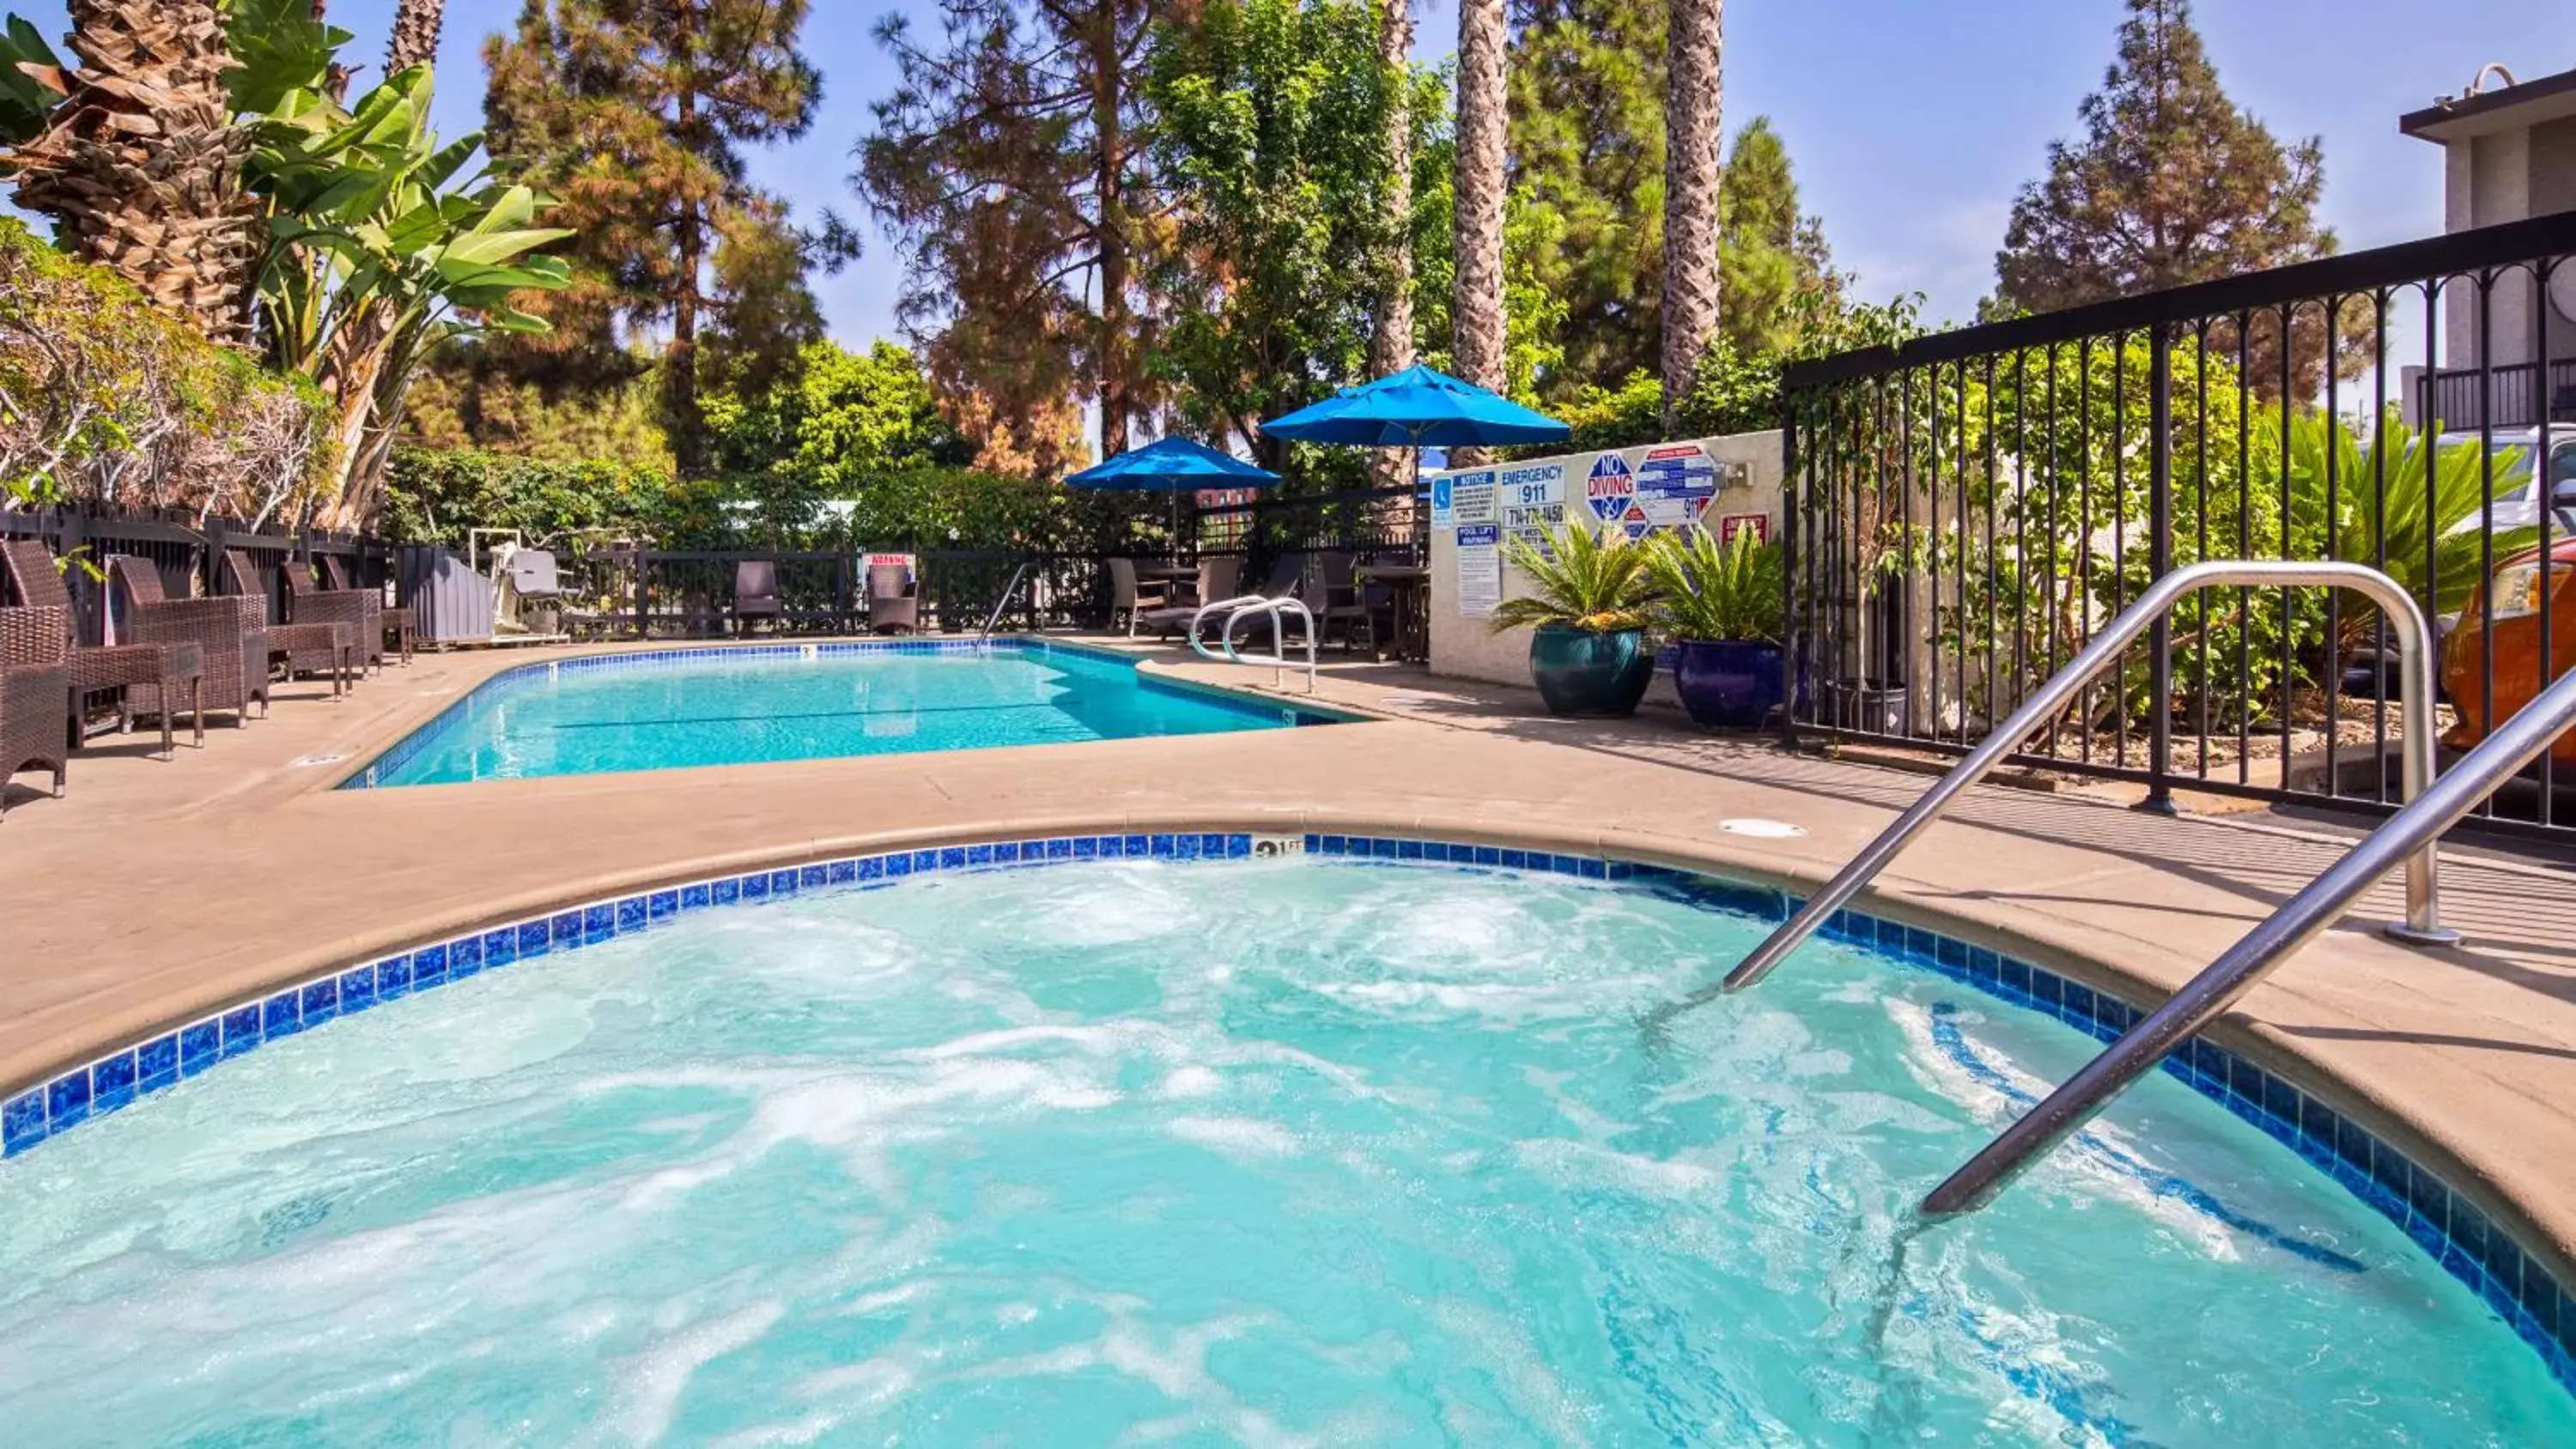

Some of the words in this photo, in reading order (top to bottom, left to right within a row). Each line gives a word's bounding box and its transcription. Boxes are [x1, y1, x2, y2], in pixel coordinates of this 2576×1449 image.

[1502, 464, 1563, 485] EMERGENCY
[1601, 456, 1620, 475] NO
[1461, 474, 1487, 486] NOTICE
[1588, 476, 1632, 496] DIVING
[1522, 483, 1546, 503] 911
[1685, 498, 1699, 519] 911
[1460, 527, 1477, 536] POOL
[1479, 526, 1493, 535] LIFT
